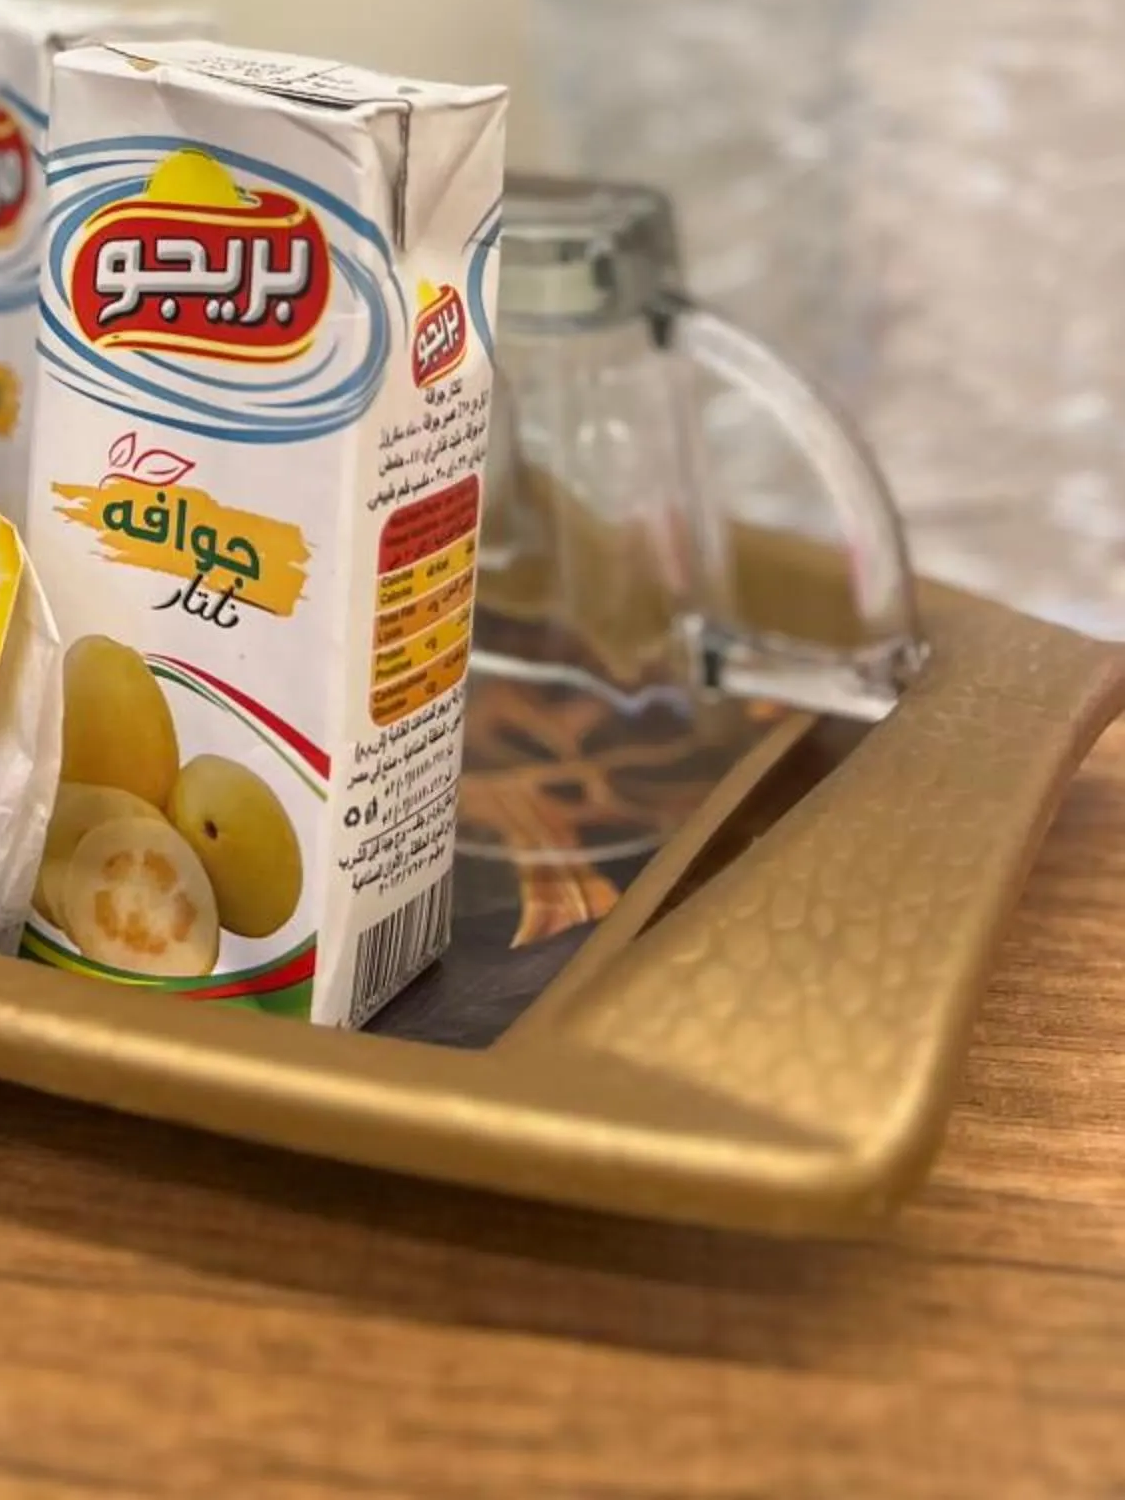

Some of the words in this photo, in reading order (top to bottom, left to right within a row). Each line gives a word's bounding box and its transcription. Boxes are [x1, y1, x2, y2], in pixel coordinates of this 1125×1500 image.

[95, 238, 310, 324] بريجو
[416, 301, 461, 374] بريجو
[102, 491, 260, 590] جوافه
